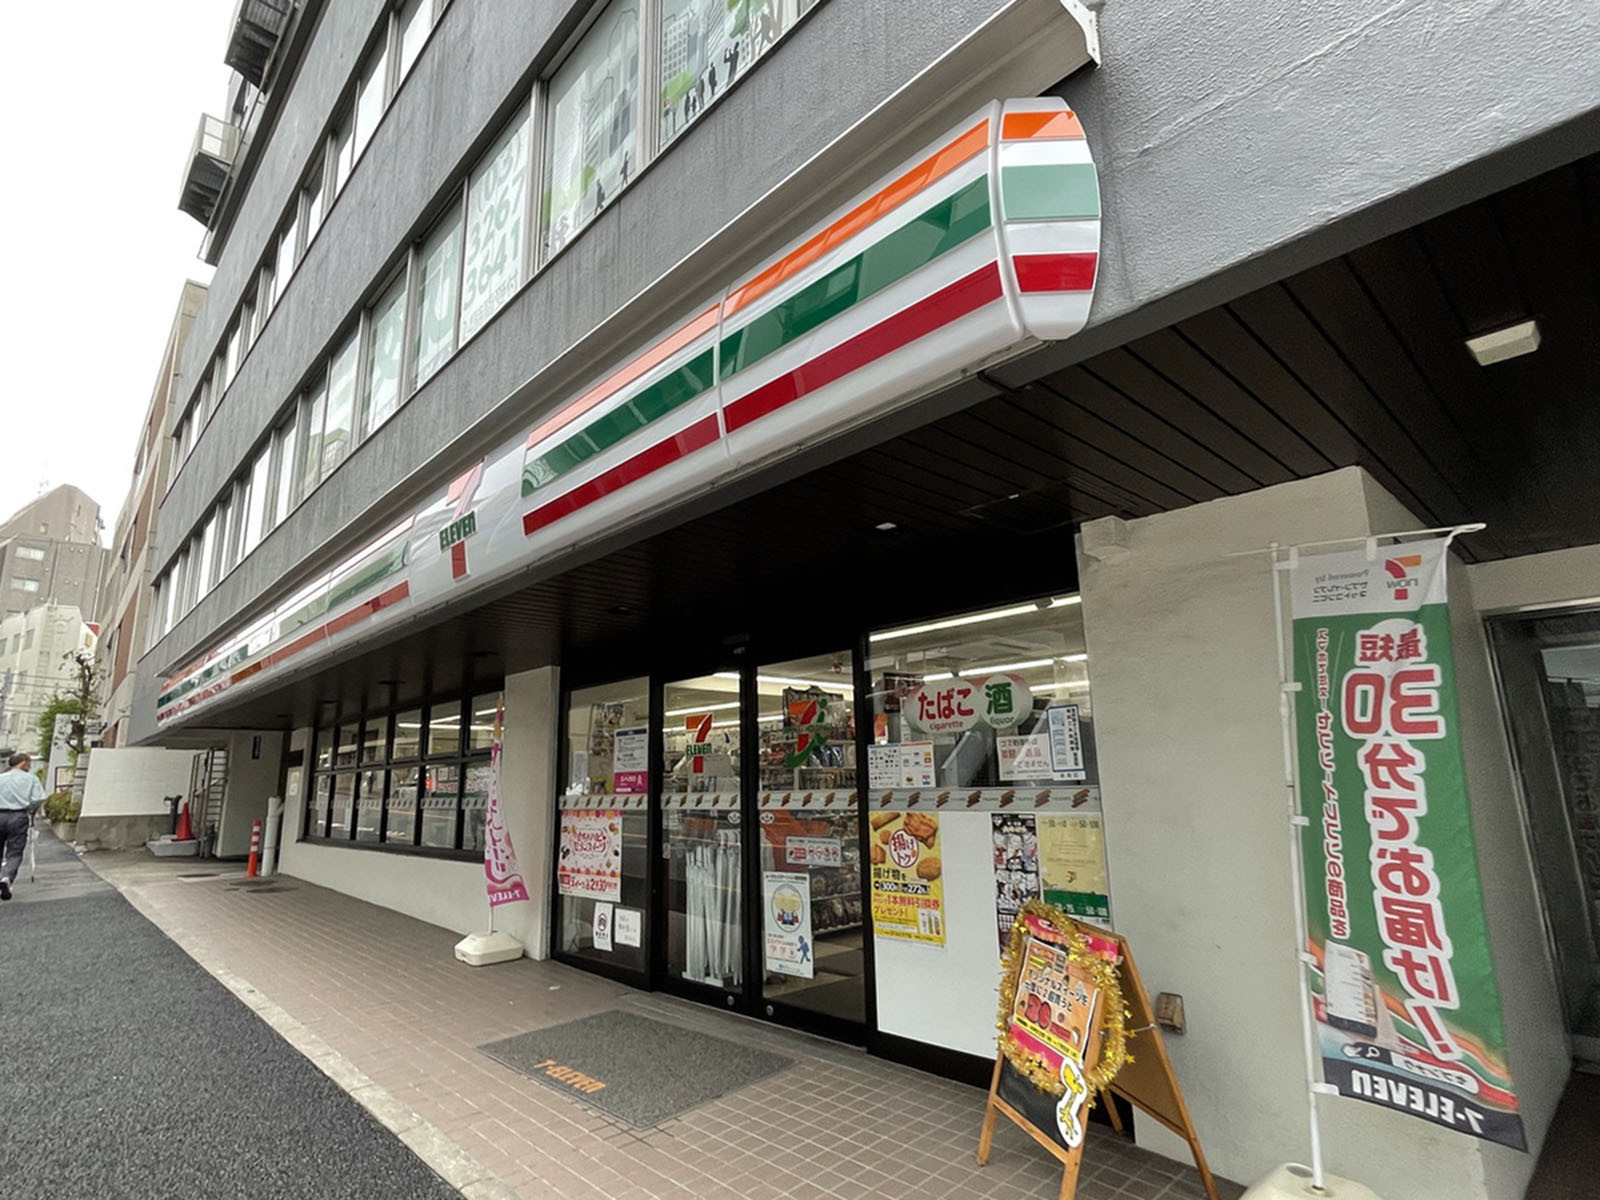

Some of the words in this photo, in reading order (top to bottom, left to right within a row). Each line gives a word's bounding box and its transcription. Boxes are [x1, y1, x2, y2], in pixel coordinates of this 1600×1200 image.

[467, 170, 525, 265] 3267
[463, 217, 522, 311] 3641
[918, 688, 974, 720] たばこ
[985, 681, 1014, 715] 酒
[891, 832, 915, 852] 揚げ
[872, 867, 907, 882] 揚げ物を
[1027, 969, 1089, 1006] オリジナルスイーツを
